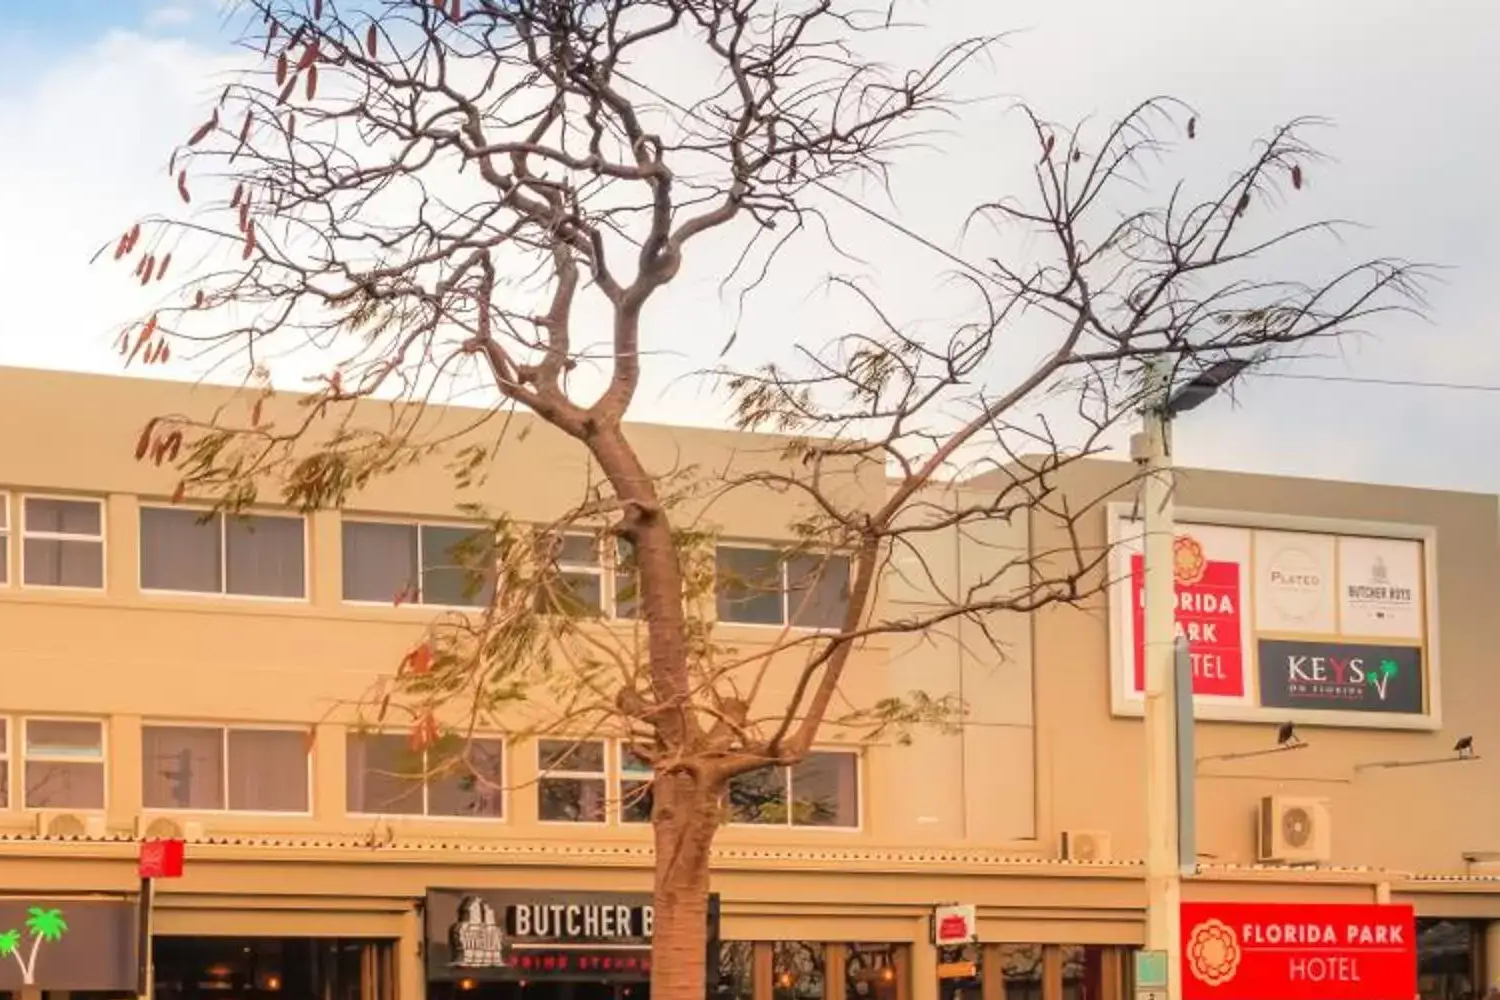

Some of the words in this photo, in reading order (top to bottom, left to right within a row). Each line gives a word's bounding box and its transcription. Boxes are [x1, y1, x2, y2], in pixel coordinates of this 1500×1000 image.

[1174, 621, 1218, 643] ARK
[1189, 653, 1228, 680] TEL
[1287, 655, 1365, 685] KEYS
[514, 904, 632, 937] BUTCHER
[1241, 924, 1337, 943] FLORIDA
[1346, 924, 1405, 943] PARK
[1288, 957, 1361, 982] HOTEL
